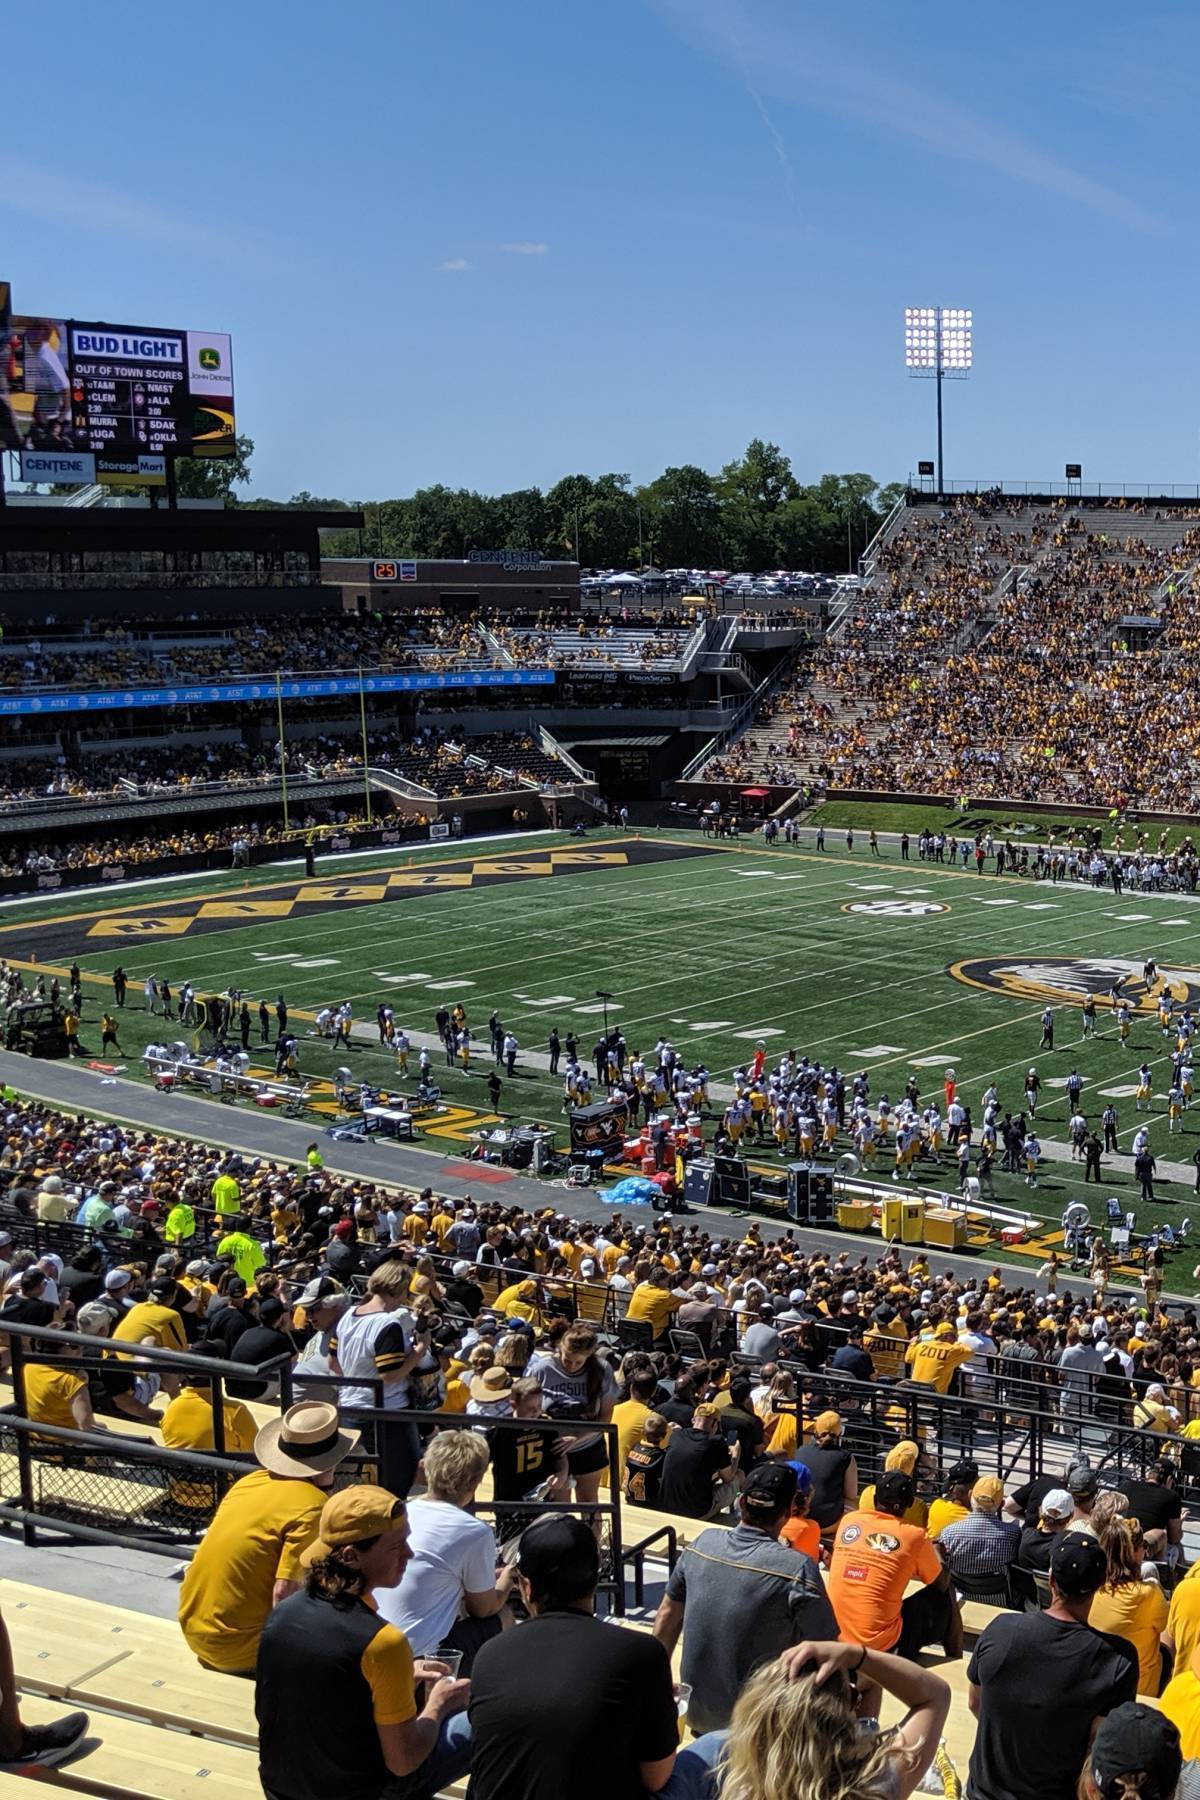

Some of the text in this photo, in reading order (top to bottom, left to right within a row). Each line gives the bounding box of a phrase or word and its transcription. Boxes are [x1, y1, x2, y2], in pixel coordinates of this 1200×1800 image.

[77, 335, 179, 358] BUD LIGHT
[75, 364, 184, 381] OUT OF TOWN SCORES
[93, 381, 116, 390] TA&M
[147, 383, 174, 394] NMST
[91, 393, 116, 403] CLEM
[152, 396, 171, 406] ALA
[89, 417, 118, 427] MURRA
[150, 420, 176, 430] SDAK
[94, 429, 116, 439] UGA
[154, 432, 178, 442] OKLA
[25, 458, 84, 473] CENTENE
[468, 550, 541, 563] CENTENE
[377, 564, 394, 578] 25
[503, 562, 552, 573] Corporation
[451, 676, 466, 684] AT&T
[489, 674, 505, 683] AT&T
[529, 673, 547, 682] AT&T
[568, 671, 602, 681] Learfield
[381, 680, 396, 688] AT&T
[416, 678, 431, 687] AT&T
[227, 689, 244, 698] AT&T
[306, 684, 323, 693] AT&T
[97, 697, 116, 705] AT&T
[142, 694, 160, 702] AT&T
[3, 702, 22, 711] AT&T
[50, 699, 69, 708] AT&T
[870, 1339, 897, 1353] ZOU
[919, 1344, 949, 1361] ZOU
[516, 1439, 544, 1474] 15
[628, 1471, 646, 1501] 4
[847, 1568, 865, 1579] mpix
